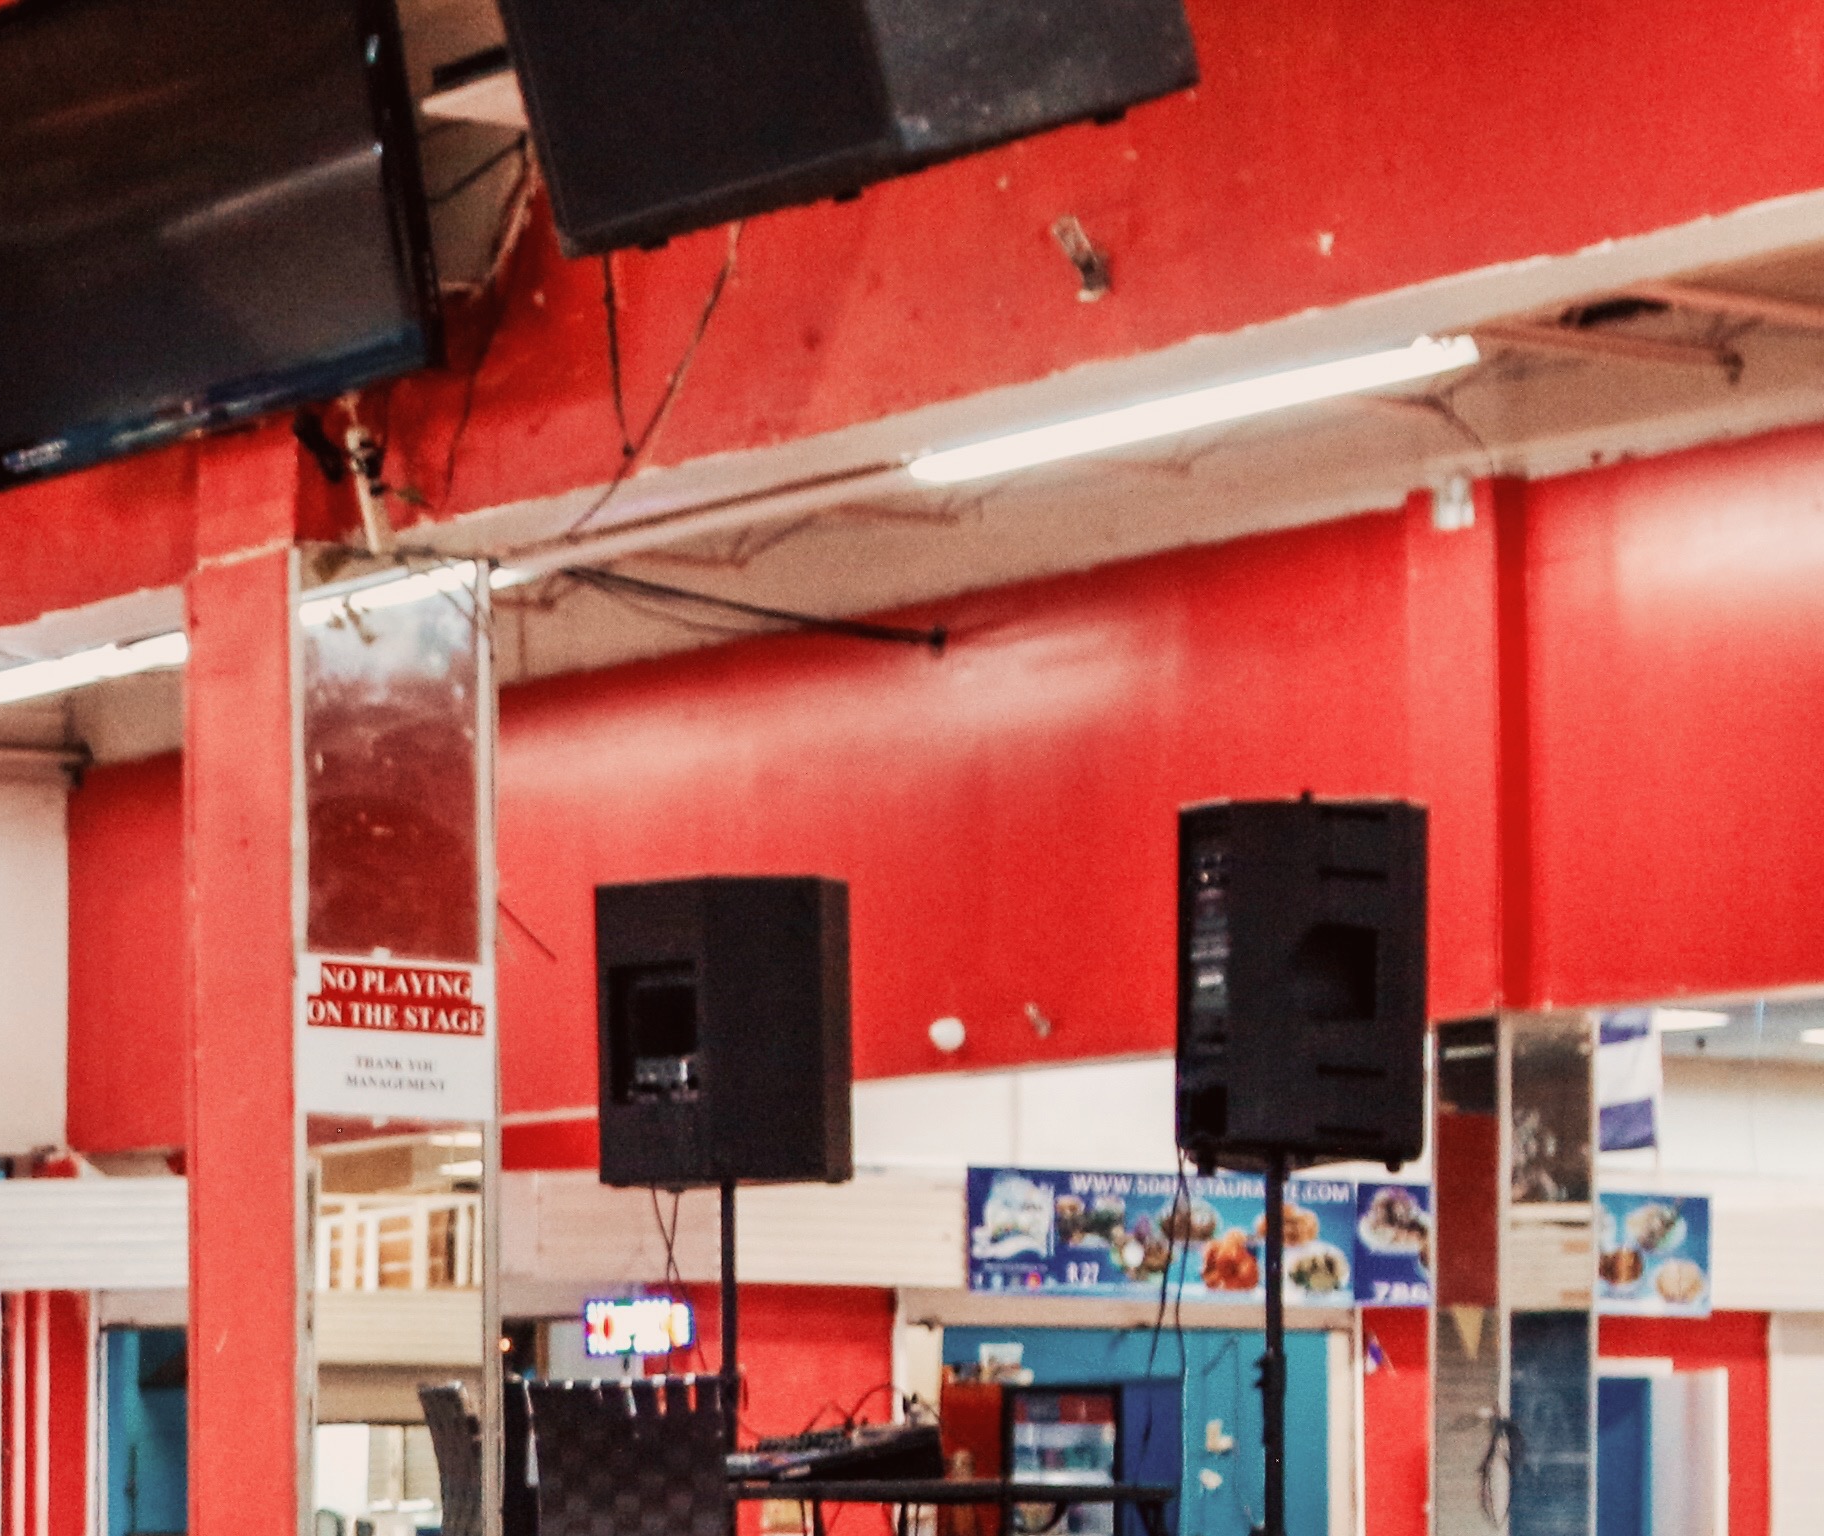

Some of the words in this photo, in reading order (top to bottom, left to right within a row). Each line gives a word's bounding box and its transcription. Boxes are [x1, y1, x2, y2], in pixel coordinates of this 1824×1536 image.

[322, 966, 357, 990] NO
[361, 969, 473, 999] PLAYING
[308, 998, 343, 1023] ON
[348, 1002, 399, 1028] THE
[404, 1006, 485, 1034] STAGE
[355, 1055, 403, 1072] THANK
[407, 1058, 435, 1073] YOU
[345, 1074, 446, 1092] MANAGEMENT
